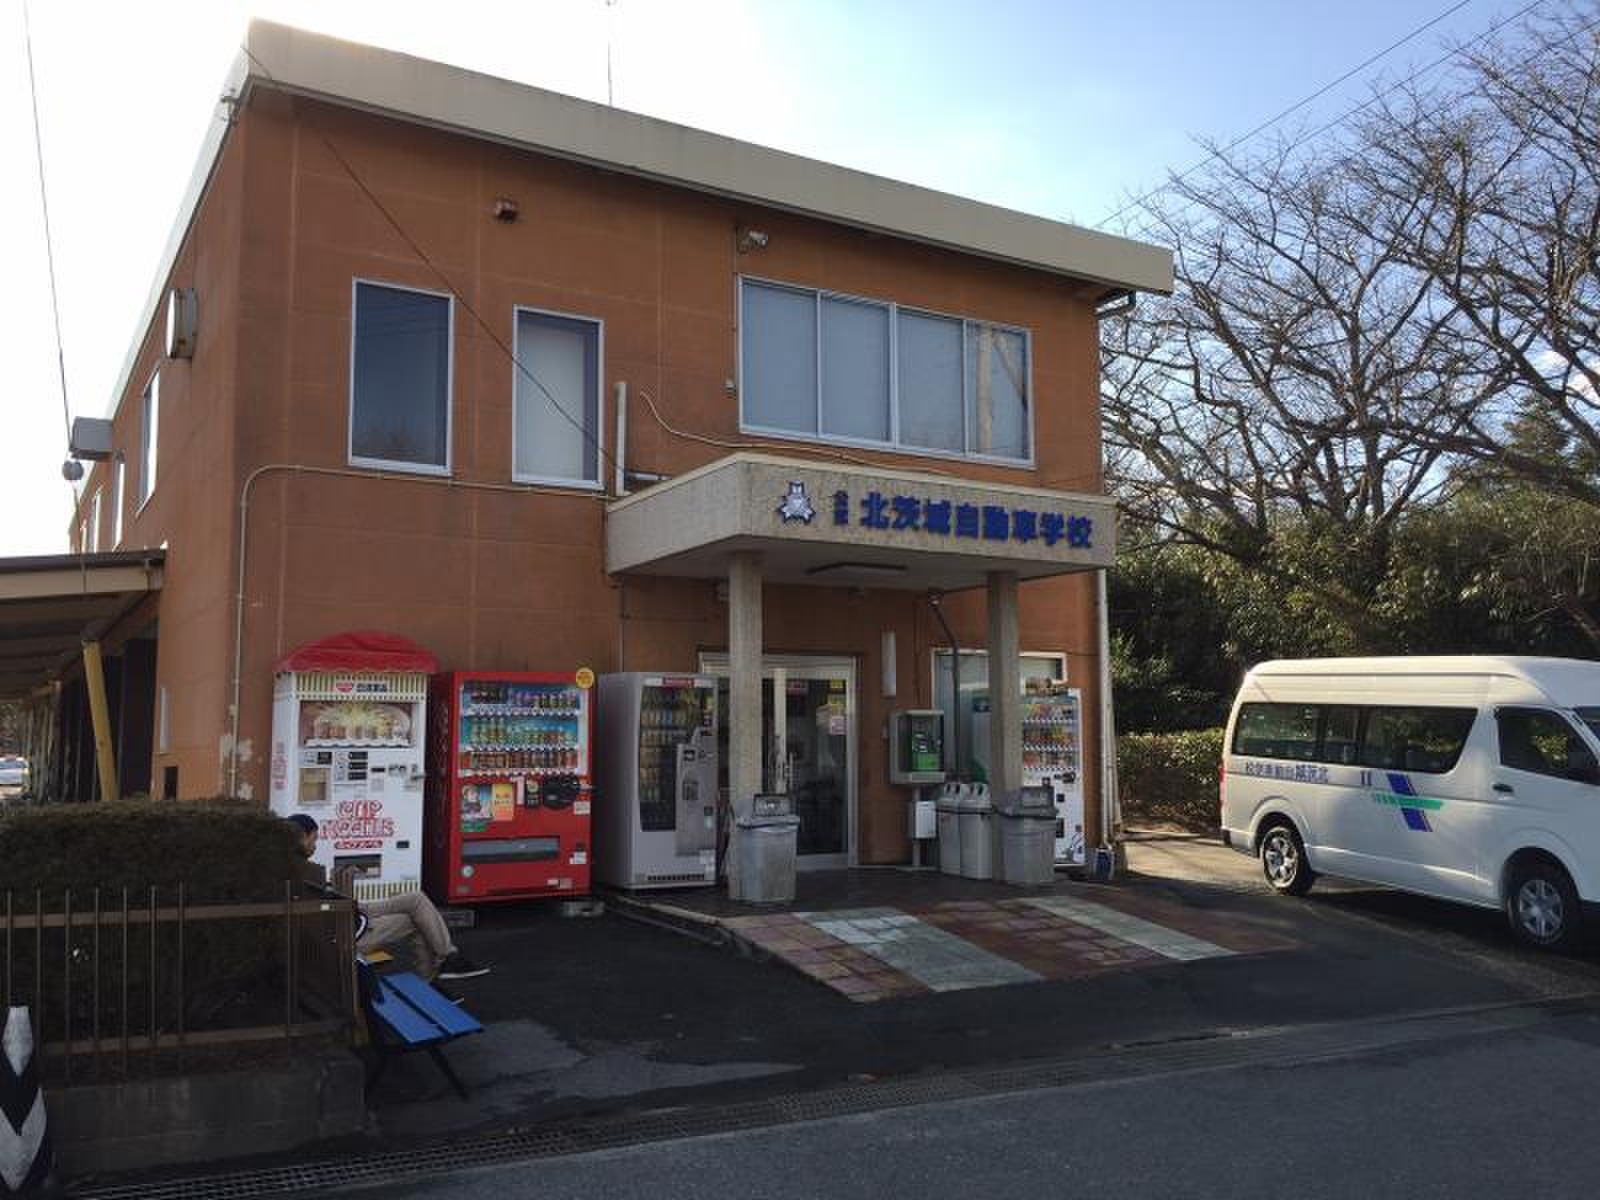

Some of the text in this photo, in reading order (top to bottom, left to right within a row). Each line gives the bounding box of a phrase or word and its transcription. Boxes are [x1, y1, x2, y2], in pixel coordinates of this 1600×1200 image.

[861, 491, 1092, 548] 北茨城自動車学校
[337, 800, 382, 820] CUP
